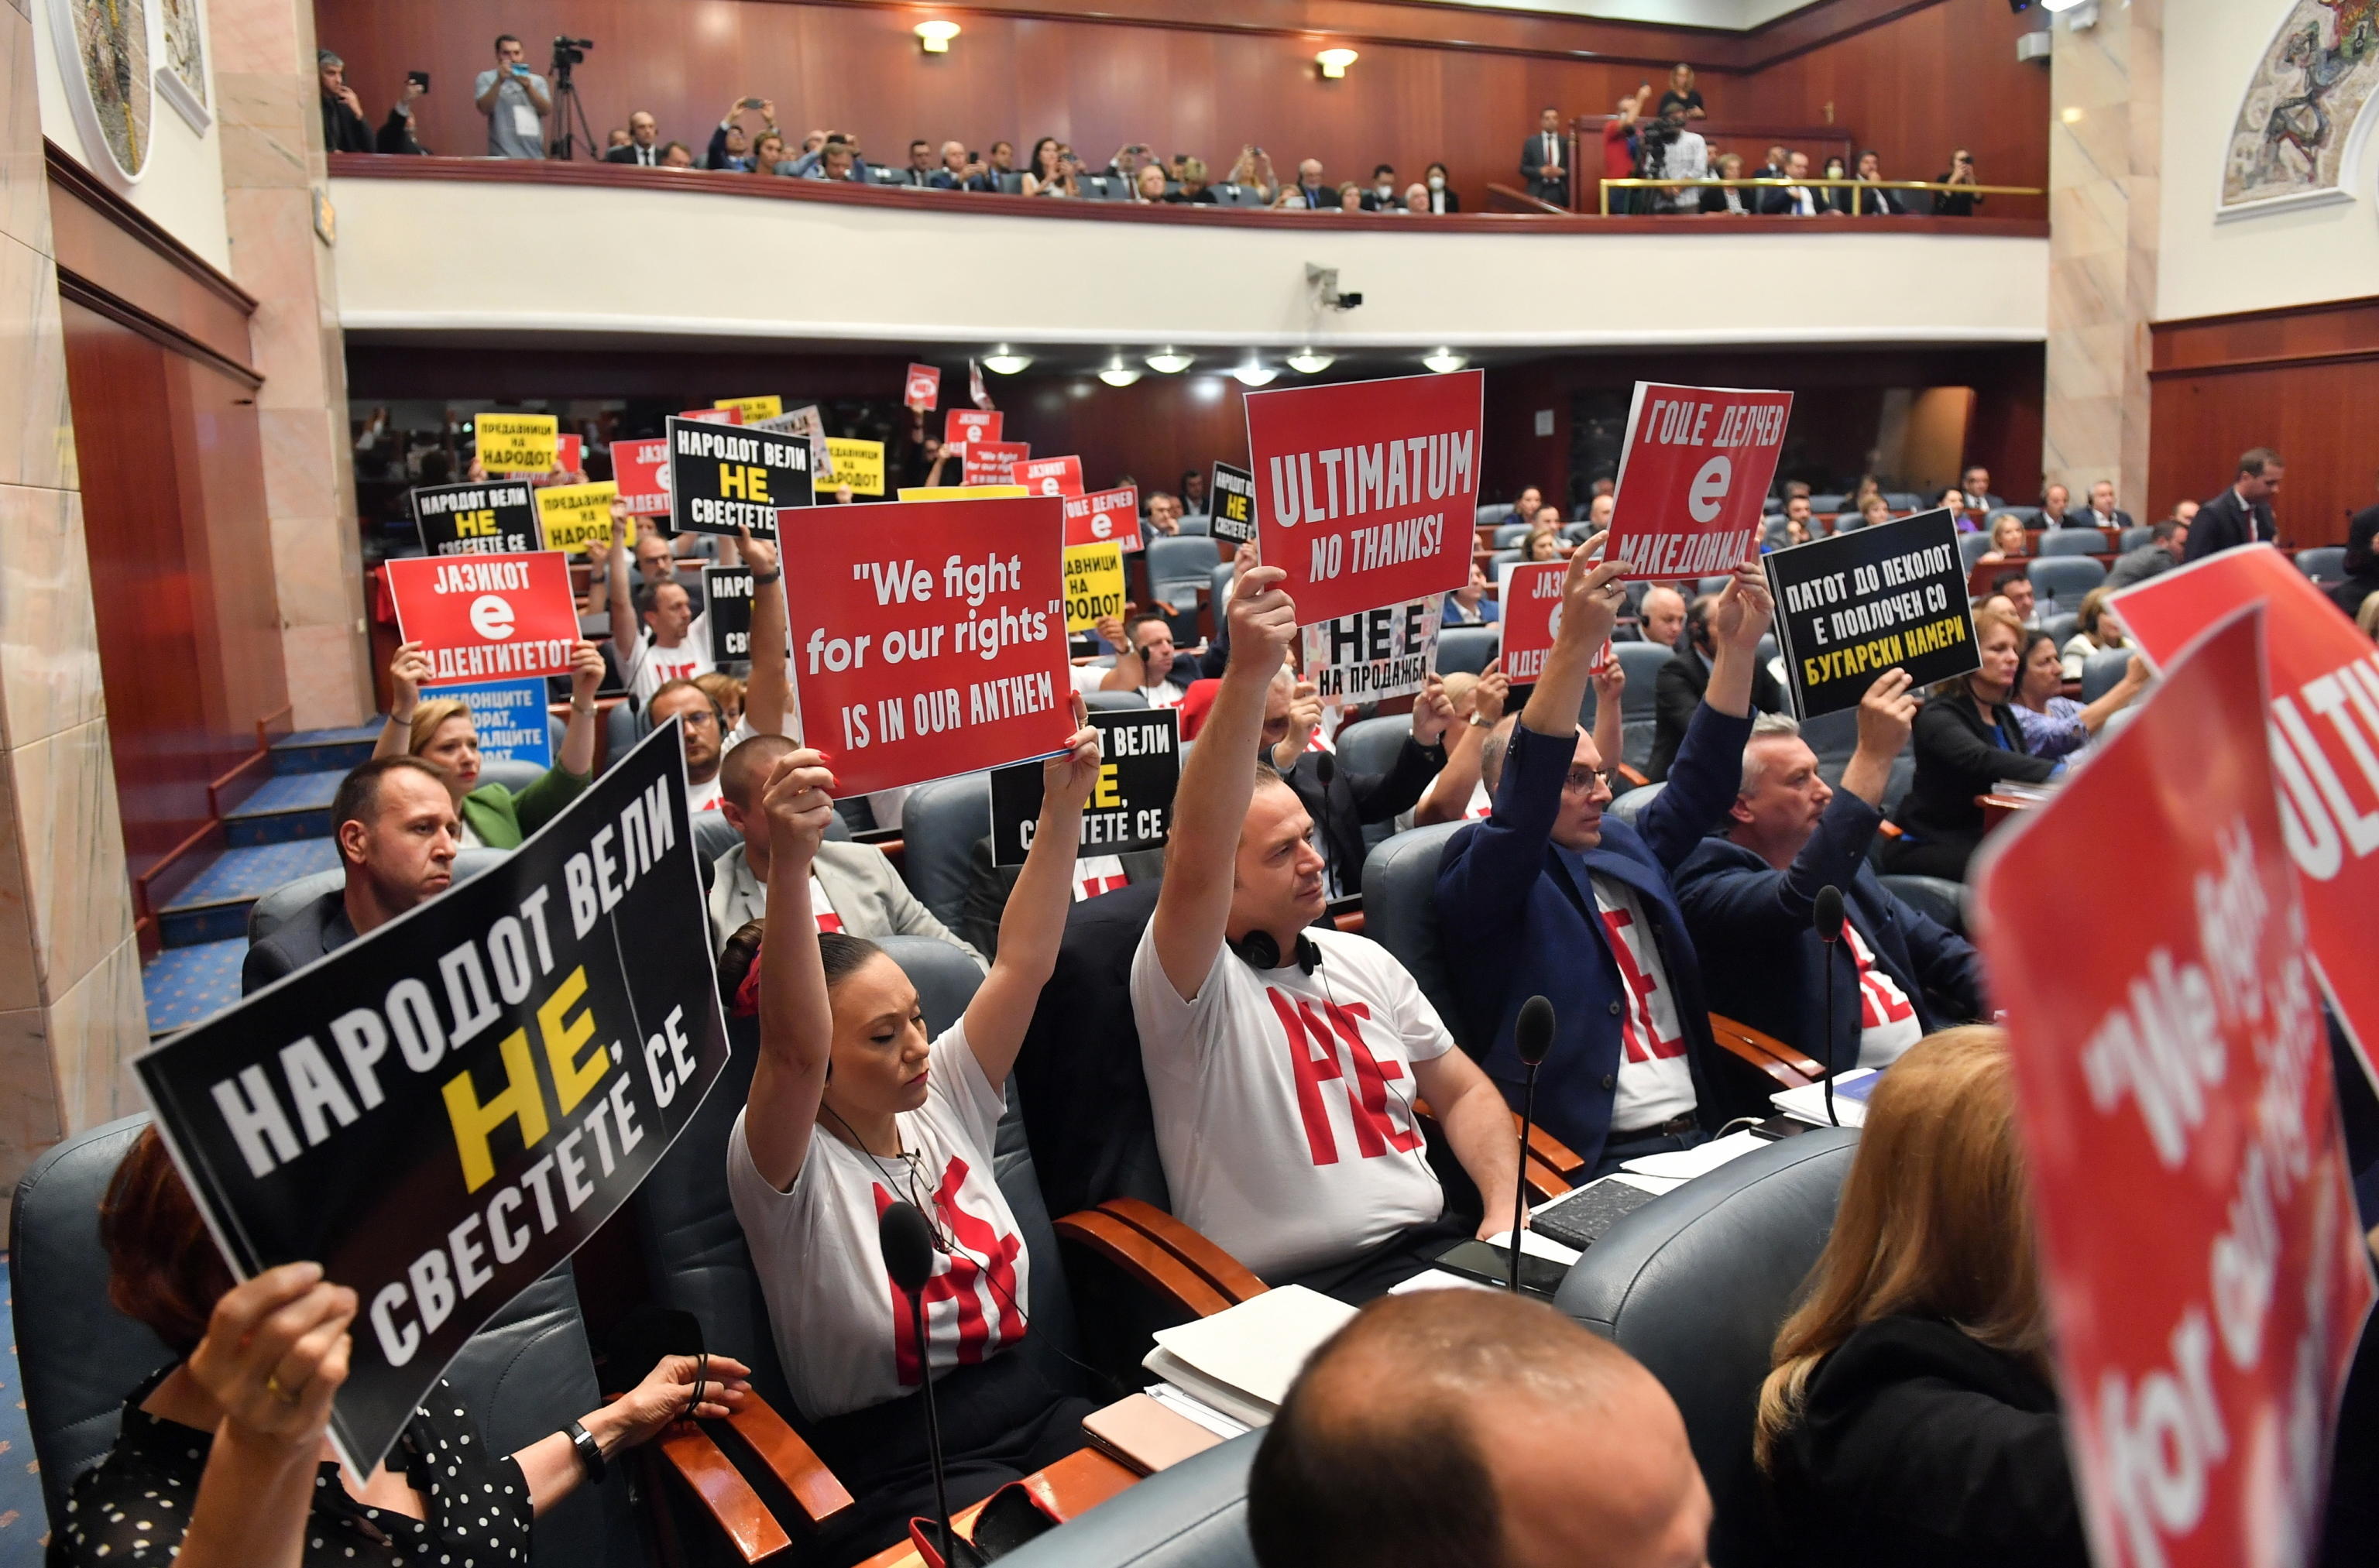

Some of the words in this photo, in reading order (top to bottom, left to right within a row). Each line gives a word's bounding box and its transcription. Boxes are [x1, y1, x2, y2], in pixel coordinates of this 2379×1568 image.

[511, 437, 524, 447] НА
[1644, 400, 1713, 446] ГОЦЕ
[1711, 405, 1785, 448] ДЕЛЧЕВ
[483, 450, 552, 466] НАРОДОТ
[636, 444, 668, 464] ЈАЗИ
[677, 430, 760, 464] НАРОДОТ
[764, 442, 807, 472] ВЕЛИ
[1269, 429, 1474, 528] ULTIMATUM
[1688, 455, 1732, 523] е
[421, 489, 486, 516] НАРОДОТ
[489, 487, 527, 507] ВЕЛИ
[581, 510, 596, 522] НА
[692, 497, 774, 530] СВЕСТЕТЕ
[1066, 499, 1090, 519] ОЦЕ
[1092, 491, 1134, 513] ДЕЛЧЕВ
[507, 534, 528, 552] СЕ
[551, 523, 610, 547] НАРОД
[1090, 513, 1112, 539] е
[1065, 556, 1118, 577] АВНИЦИ
[1309, 534, 1343, 583] NO
[1351, 512, 1444, 574] THANKS!
[1617, 529, 1751, 575] МАКЕДОНИЈА
[433, 561, 529, 595] ЈАЗИКОТ
[712, 575, 754, 598] НАРО
[853, 559, 934, 606] "We
[942, 552, 1022, 607] fight
[1070, 578, 1088, 594] НА
[1786, 572, 1849, 614] ПАТОТ
[1853, 564, 1880, 596] ДО
[1881, 544, 1953, 588] ПЕКОЛОТ
[469, 594, 516, 640] е
[1066, 594, 1121, 621] РОДОТ
[1812, 617, 1828, 646] Е
[1831, 589, 1925, 641] ПОПЛОЧЕН
[1925, 583, 1948, 613] СО
[806, 627, 871, 675] for
[882, 624, 946, 664] our
[954, 599, 1060, 660] rights"
[1330, 609, 1392, 665] НЕ
[1404, 604, 1424, 655] Е
[1804, 634, 1904, 687] БУГАРСКИ
[1904, 615, 1966, 658] НАМЕРИ
[425, 638, 573, 679] ИДЕНТИТЕТОТ
[1319, 670, 1343, 696] НА
[1350, 655, 1427, 694] ПРОДАЖБА
[841, 703, 870, 751] IS
[877, 697, 905, 743] IN
[913, 688, 962, 736] OUR
[970, 671, 1055, 726] ANTHEM
[1113, 723, 1170, 757] ВЕЛИ
[1083, 763, 1128, 809] Е,
[1137, 808, 1162, 840] СЕ
[211, 884, 556, 1179] НАРОДОТ
[563, 774, 676, 942] ВЕЛИ
[440, 963, 626, 1196] НЕ,
[1265, 986, 1424, 1166] НЕ
[369, 1063, 645, 1369] СВЕСТЕТЕ
[644, 1004, 696, 1110] СЕ
